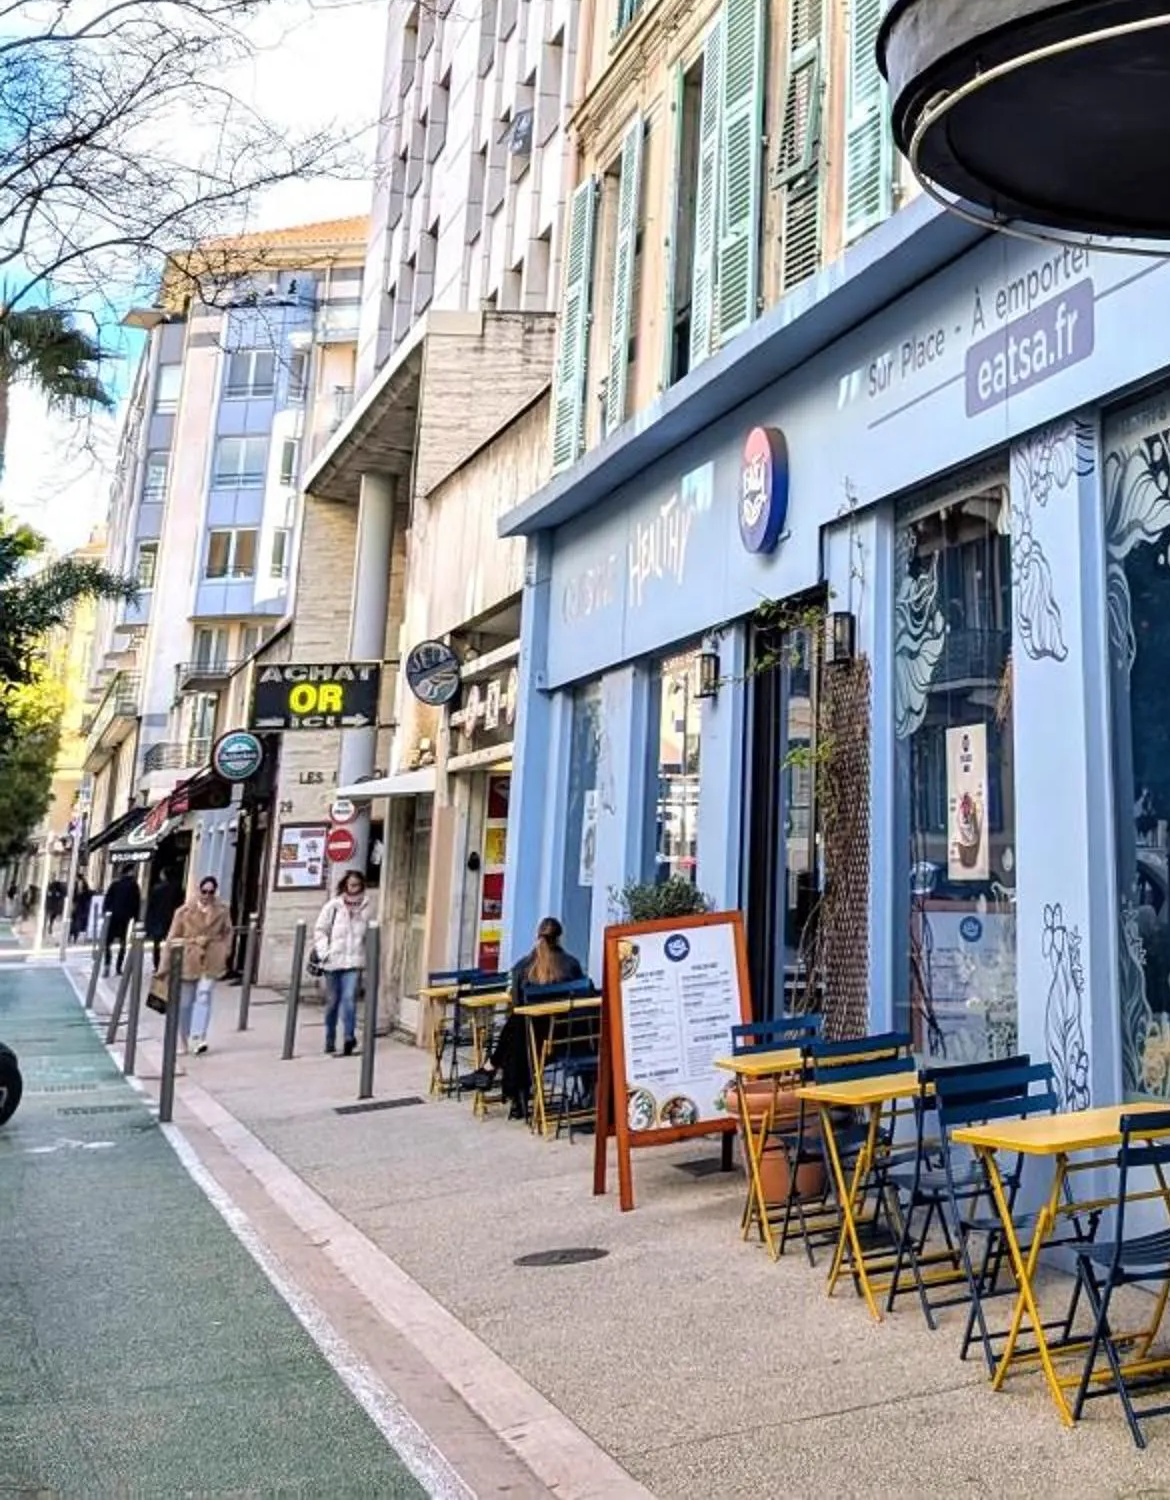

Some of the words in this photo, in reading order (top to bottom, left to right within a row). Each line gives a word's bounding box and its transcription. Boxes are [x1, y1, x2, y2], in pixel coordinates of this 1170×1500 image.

[868, 361, 893, 398] Sur
[901, 329, 945, 380] Place
[978, 303, 1079, 400] eatsa.fr
[260, 665, 376, 682] ACHAT
[289, 683, 343, 714] OR
[299, 771, 324, 785] LES
